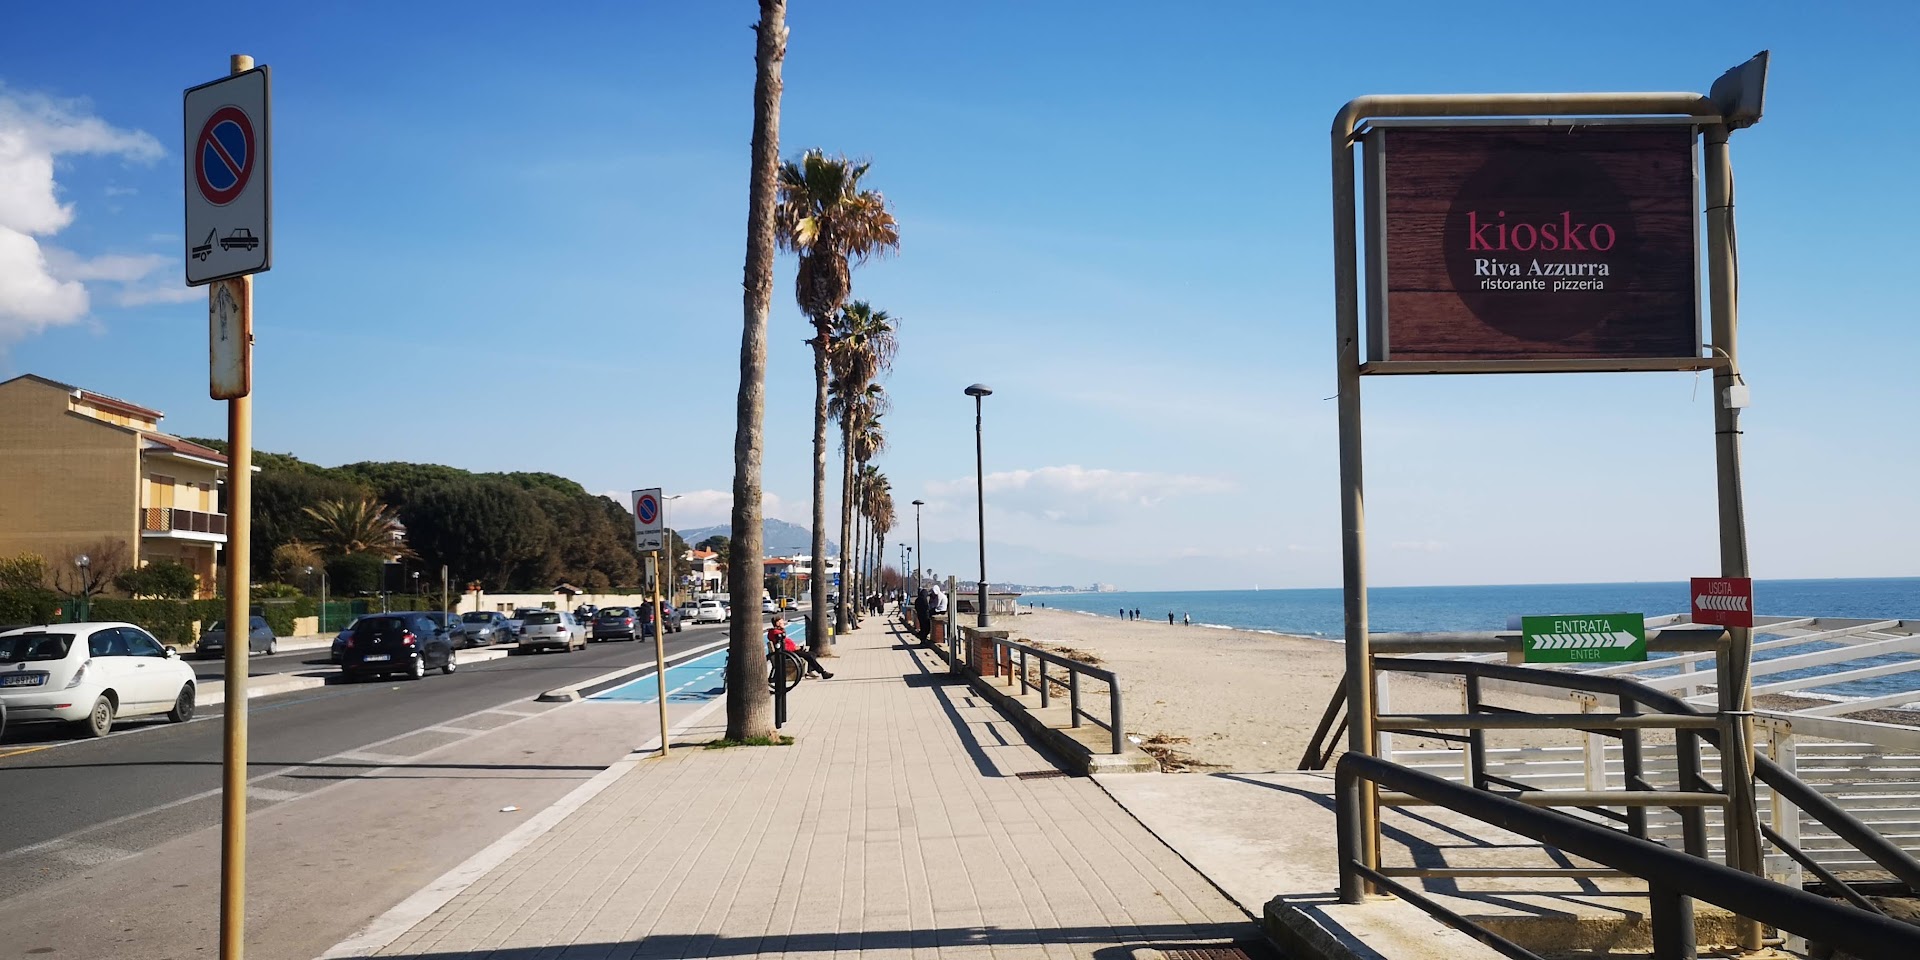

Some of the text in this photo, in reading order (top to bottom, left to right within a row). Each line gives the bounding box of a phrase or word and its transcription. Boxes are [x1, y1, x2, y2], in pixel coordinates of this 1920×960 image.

[1466, 211, 1616, 251] kiosko
[1474, 258, 1610, 276] Riva Azzurra
[1481, 278, 1604, 292] ristorante pizzeria
[1708, 582, 1732, 595] USCITA
[1554, 619, 1611, 634] ENTRATA
[1570, 649, 1601, 660] ENTER
